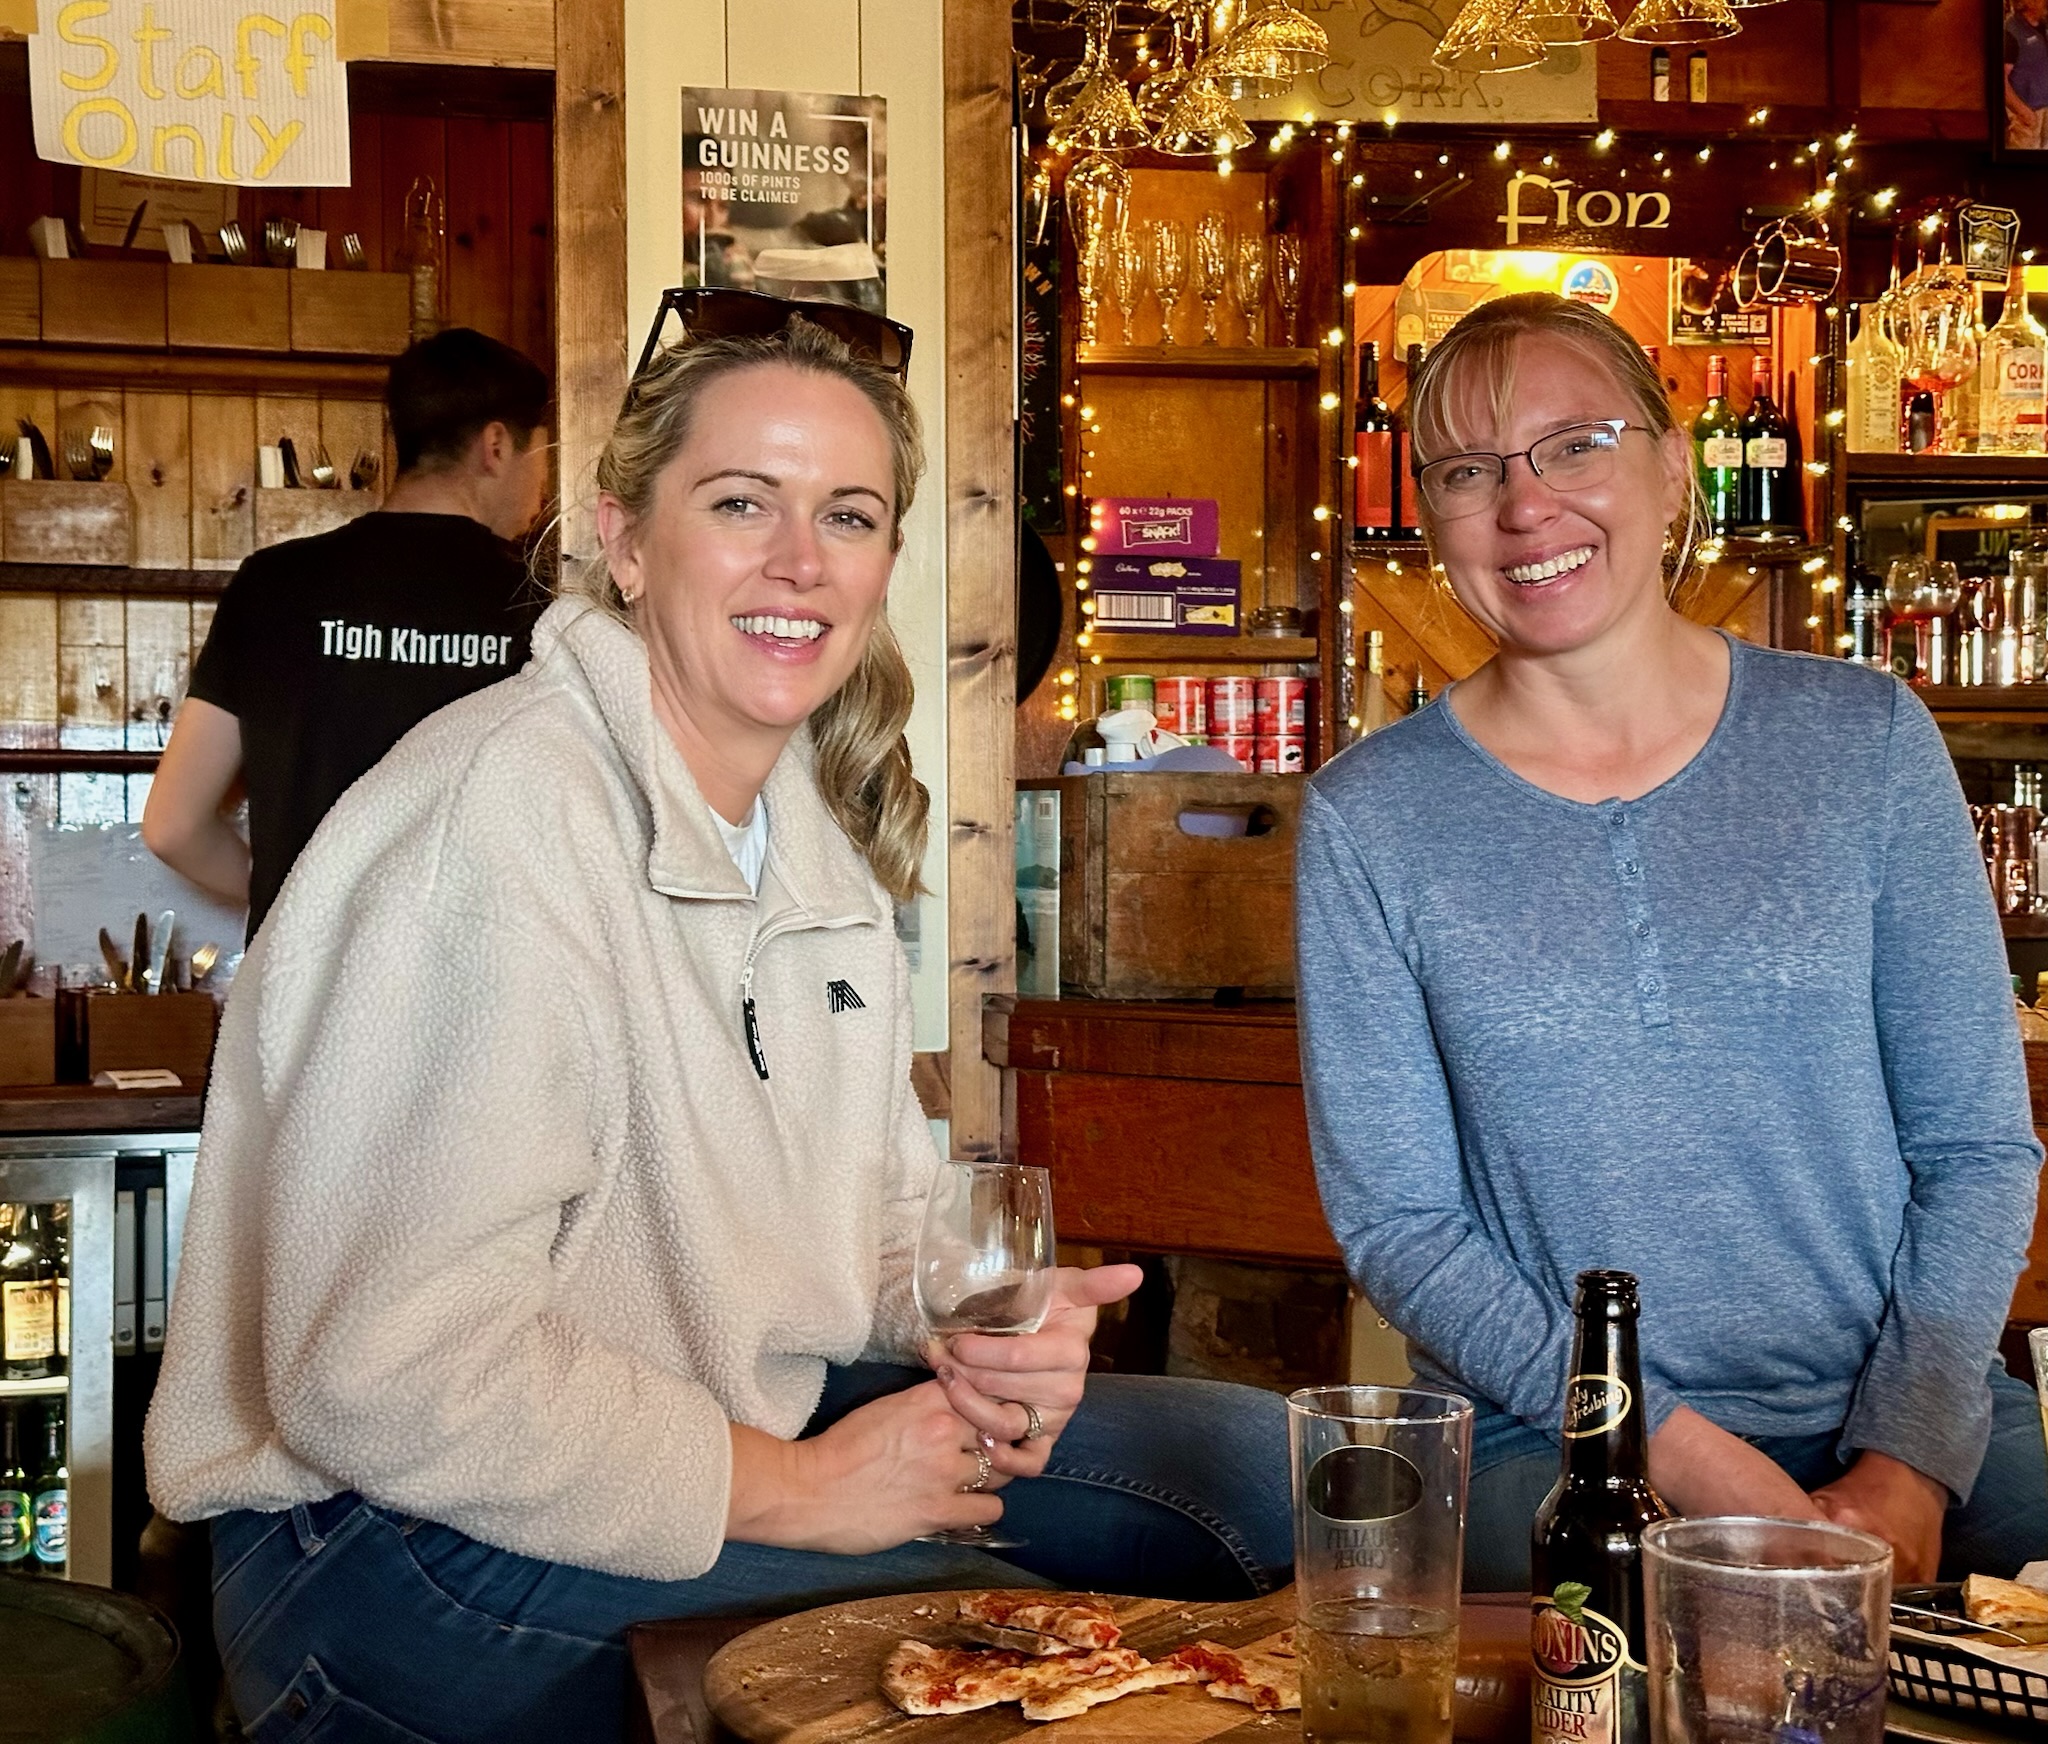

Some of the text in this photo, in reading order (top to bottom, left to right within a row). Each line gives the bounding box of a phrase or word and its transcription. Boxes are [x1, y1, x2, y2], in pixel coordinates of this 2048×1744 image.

[57, 0, 332, 100] Staff
[698, 107, 788, 139] WIN A
[62, 96, 305, 181] Only
[699, 138, 850, 175] GUINNESS
[700, 171, 801, 190] 1000s OF PINTS
[700, 187, 717, 199] TO
[721, 188, 737, 201] BE
[1968, 208, 2011, 223] HOPKINS
[1974, 271, 2001, 281] POLICE
[1119, 506, 1131, 515] 60
[1149, 507, 1165, 517] 22g
[1166, 507, 1193, 516] PACKS
[1142, 522, 1181, 539] SNACK!
[320, 620, 512, 668] Tigh Khruger
